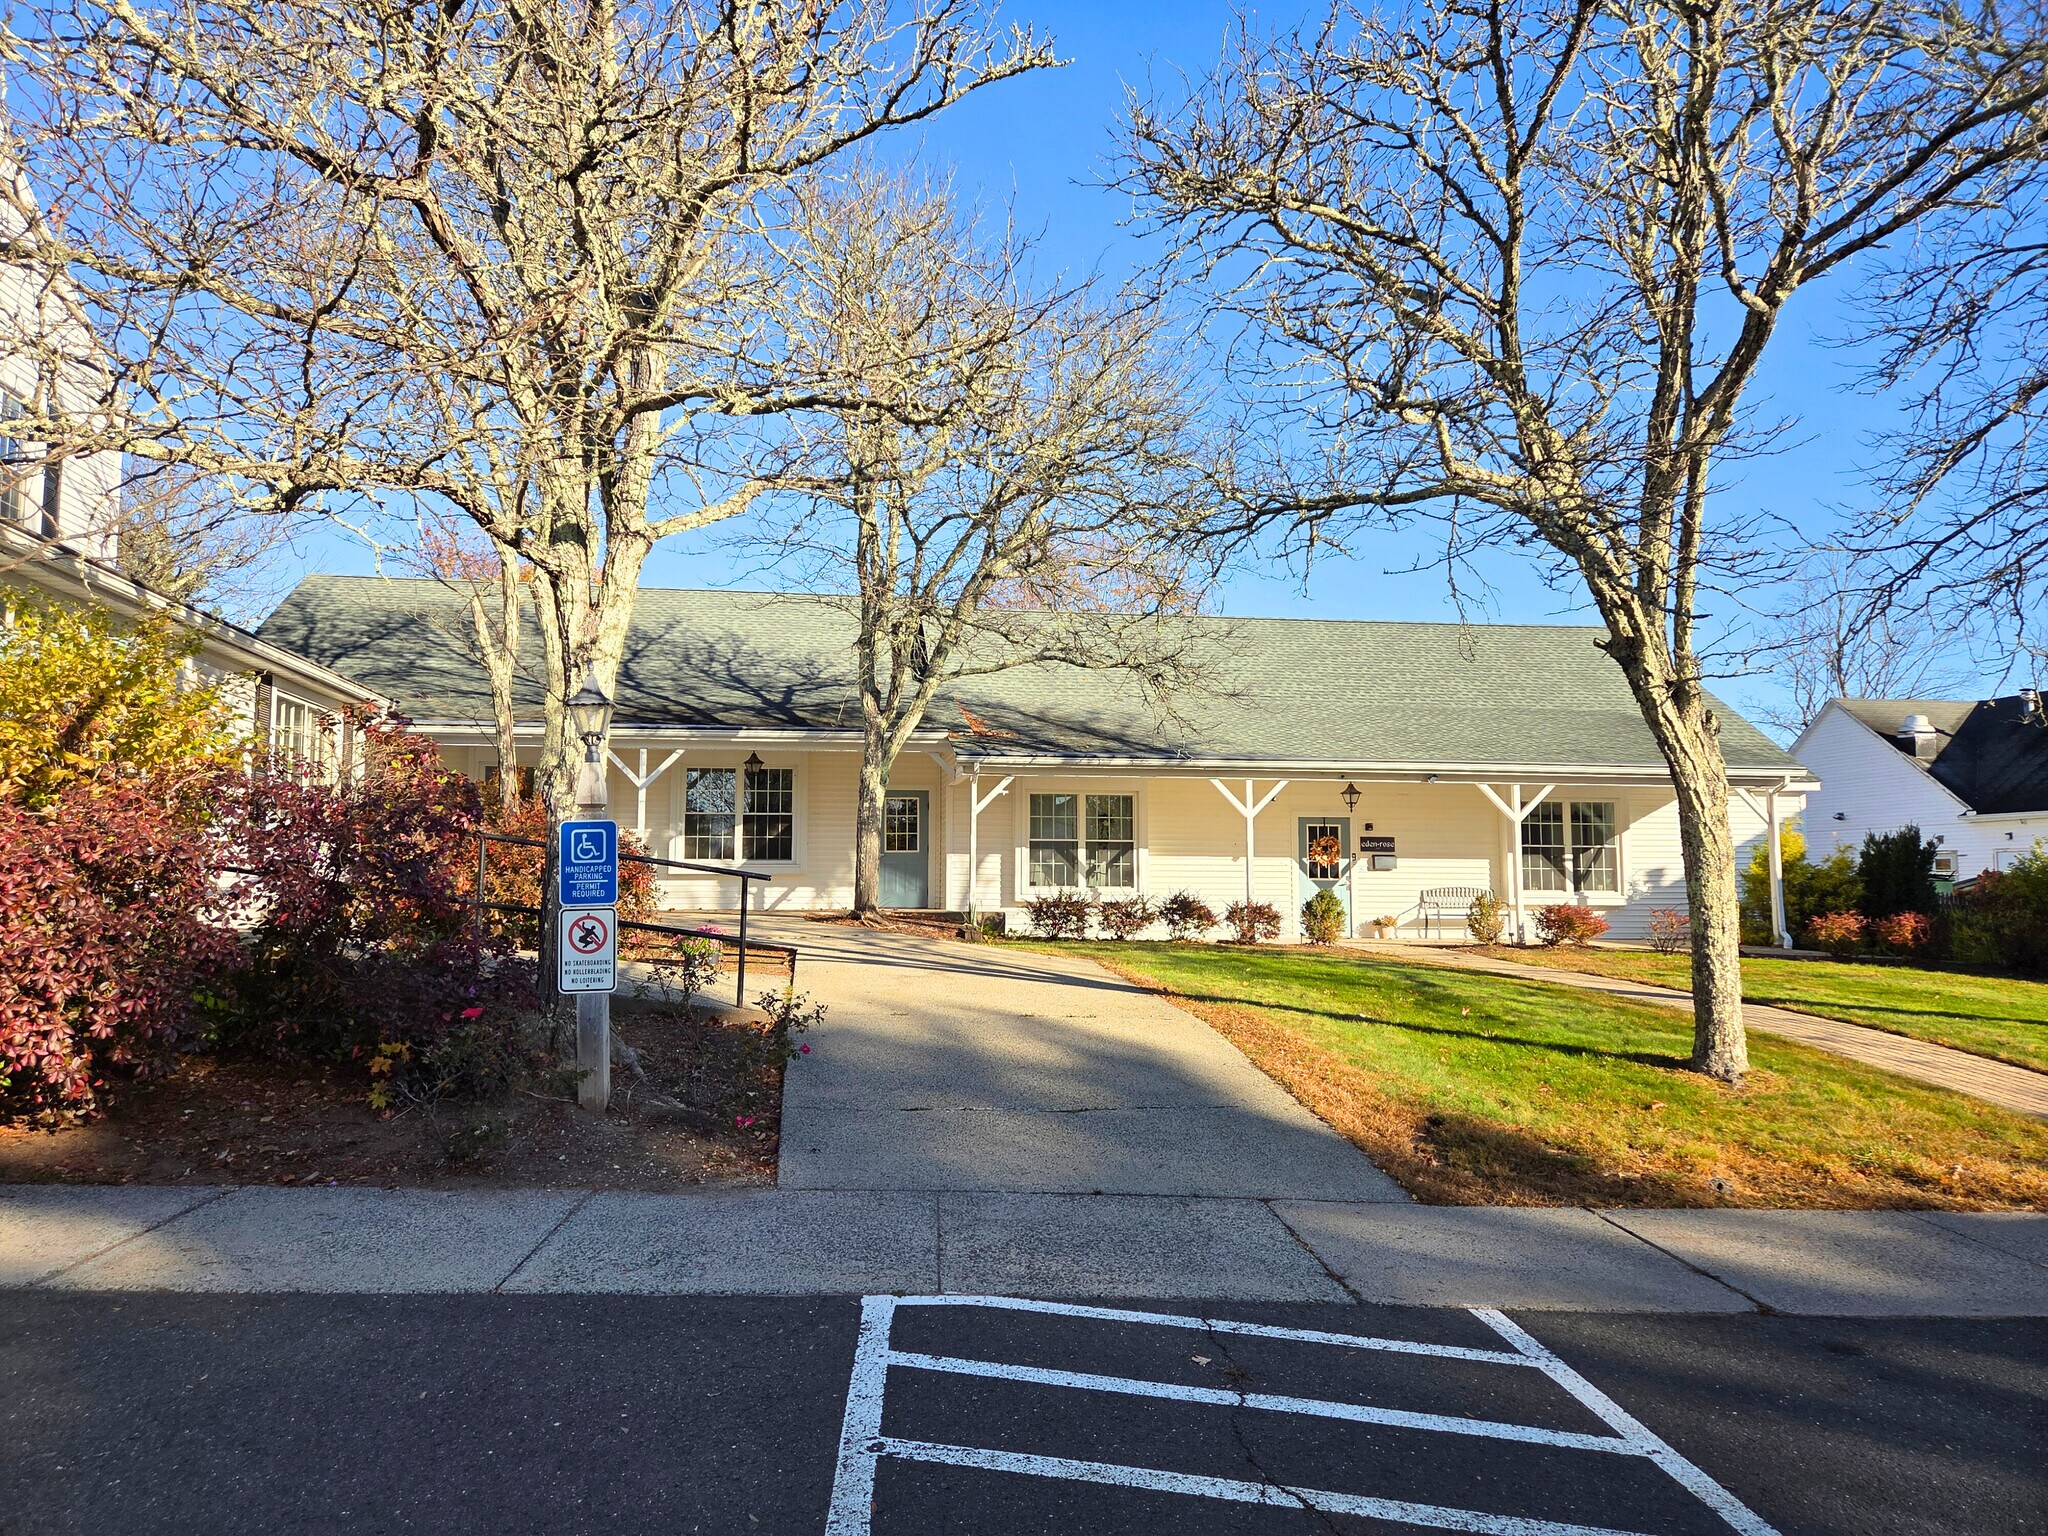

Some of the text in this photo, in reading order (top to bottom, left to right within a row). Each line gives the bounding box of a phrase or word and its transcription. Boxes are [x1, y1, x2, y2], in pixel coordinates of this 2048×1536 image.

[565, 865, 612, 873] HANDICAPPED
[576, 882, 601, 890] PERMIT
[572, 959, 611, 967] SKATEBOARDING
[572, 967, 611, 975] ROLLERBLADING
[579, 976, 605, 984] LOITERING
